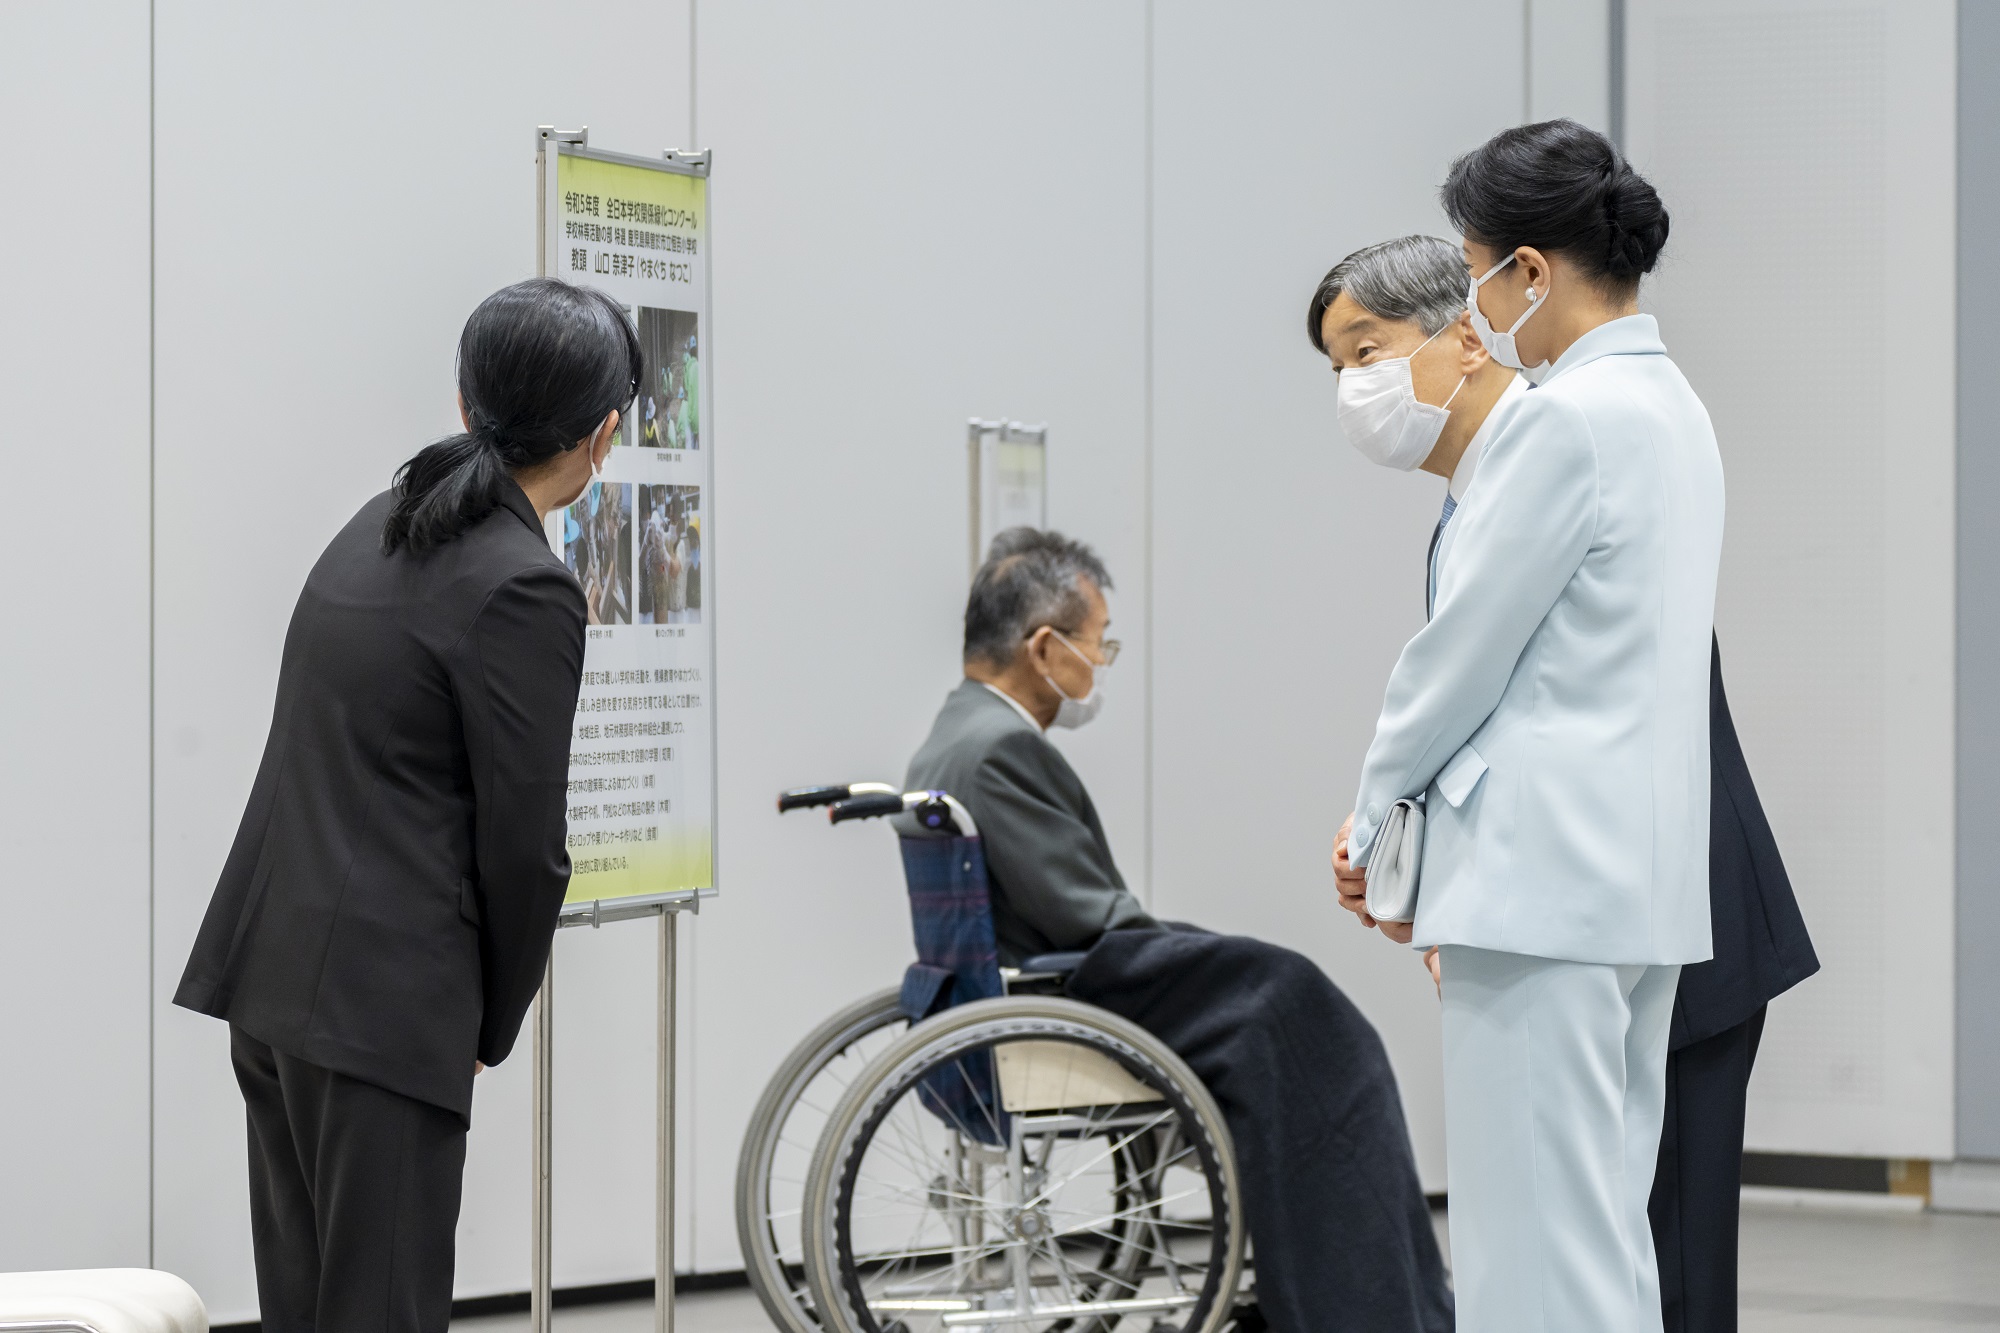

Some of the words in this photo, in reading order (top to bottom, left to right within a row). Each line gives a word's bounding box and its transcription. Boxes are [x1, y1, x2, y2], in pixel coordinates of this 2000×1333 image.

[565, 191, 600, 217] 令和5年度
[606, 197, 697, 230] 全日本学校関係緑化コンクール
[565, 220, 613, 244] 学校林等活動の部
[571, 247, 587, 272] 教頭
[594, 250, 610, 274] 山口
